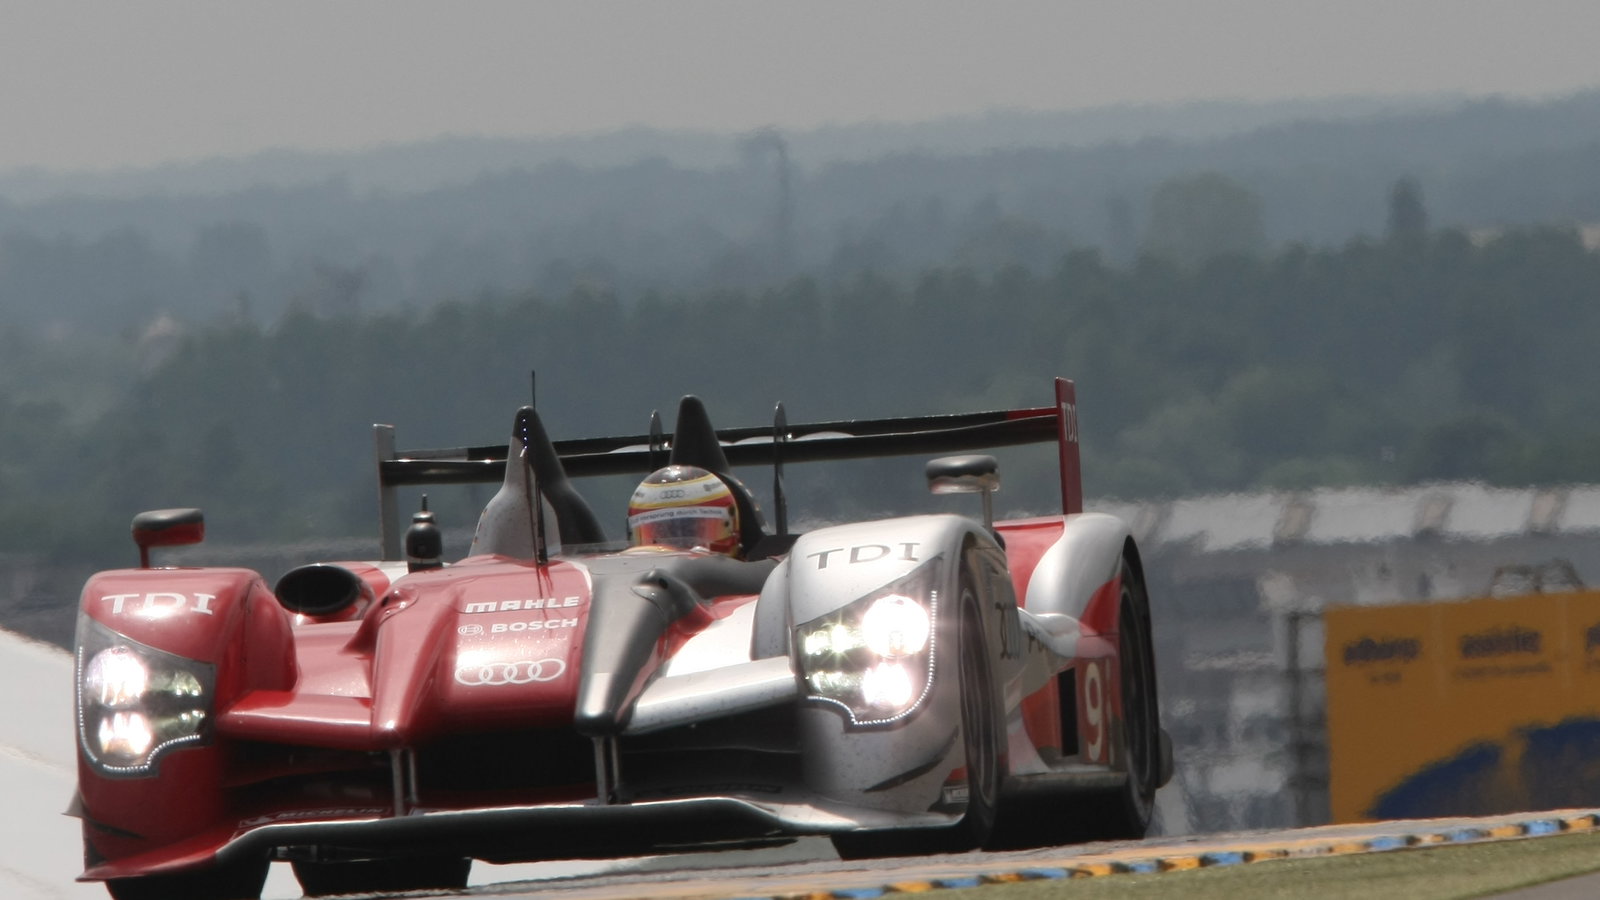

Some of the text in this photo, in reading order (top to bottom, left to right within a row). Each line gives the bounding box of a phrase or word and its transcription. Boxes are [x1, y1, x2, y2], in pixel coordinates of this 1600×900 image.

[807, 542, 920, 569] TDI
[101, 592, 216, 615] TDI
[465, 596, 580, 613] MAHLE
[491, 618, 578, 633] BOSCH
[1085, 661, 1103, 762] 9
